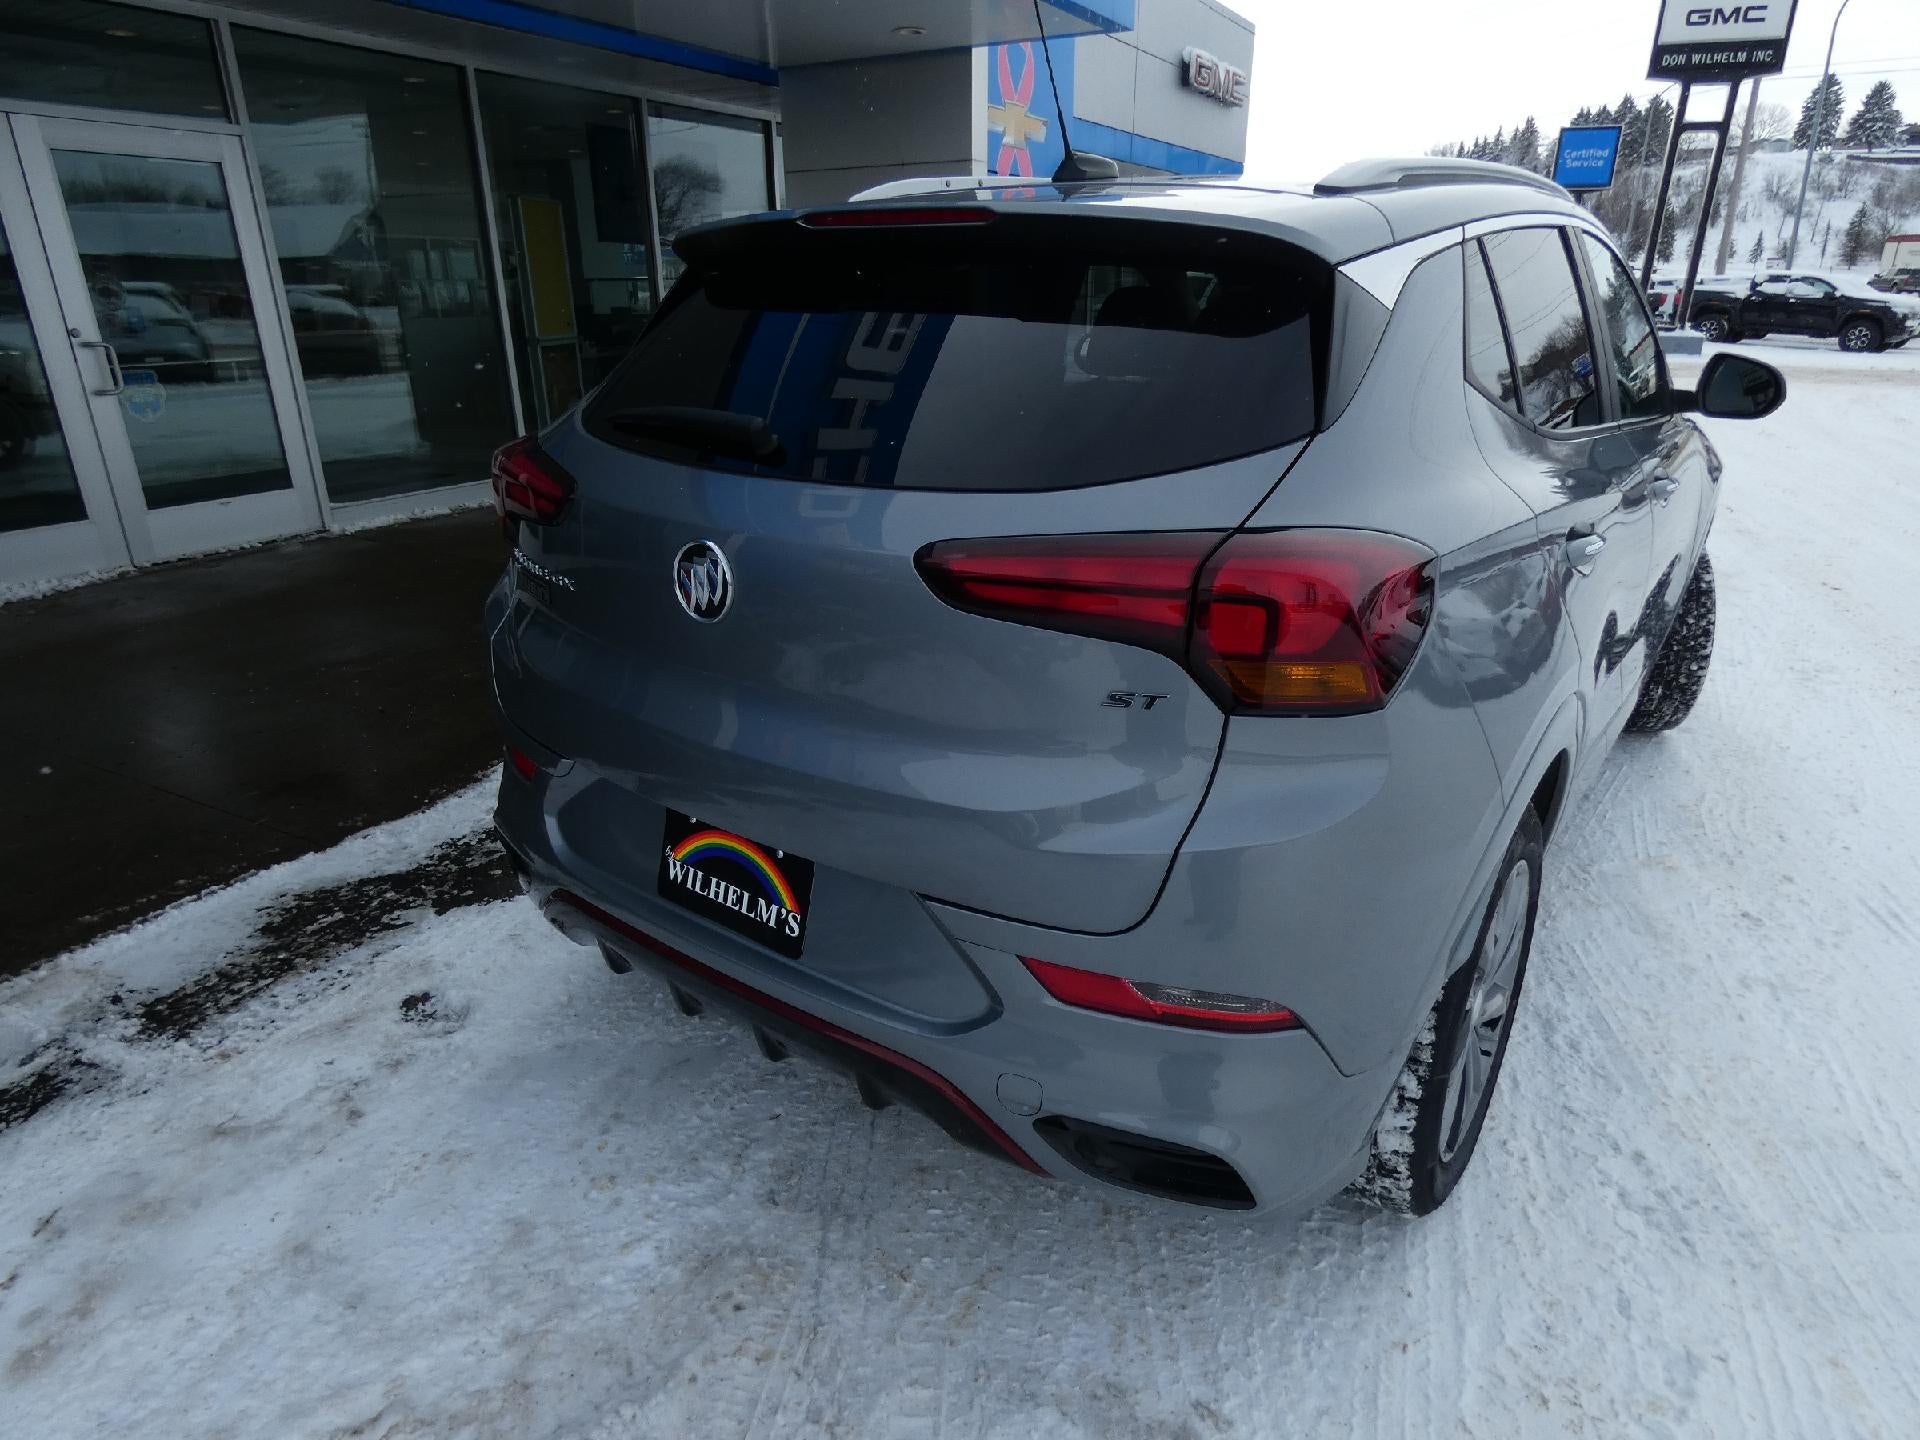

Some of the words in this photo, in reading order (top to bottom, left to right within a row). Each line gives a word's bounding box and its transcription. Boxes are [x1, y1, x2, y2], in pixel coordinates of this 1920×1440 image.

[1686, 5, 1768, 26] GMC
[1662, 54, 1686, 66] DON
[1691, 51, 1747, 65] WILHELM
[1188, 49, 1247, 104] GMC
[1564, 148, 1610, 160] Certified
[1565, 159, 1604, 168] Service
[1101, 691, 1170, 710] ST
